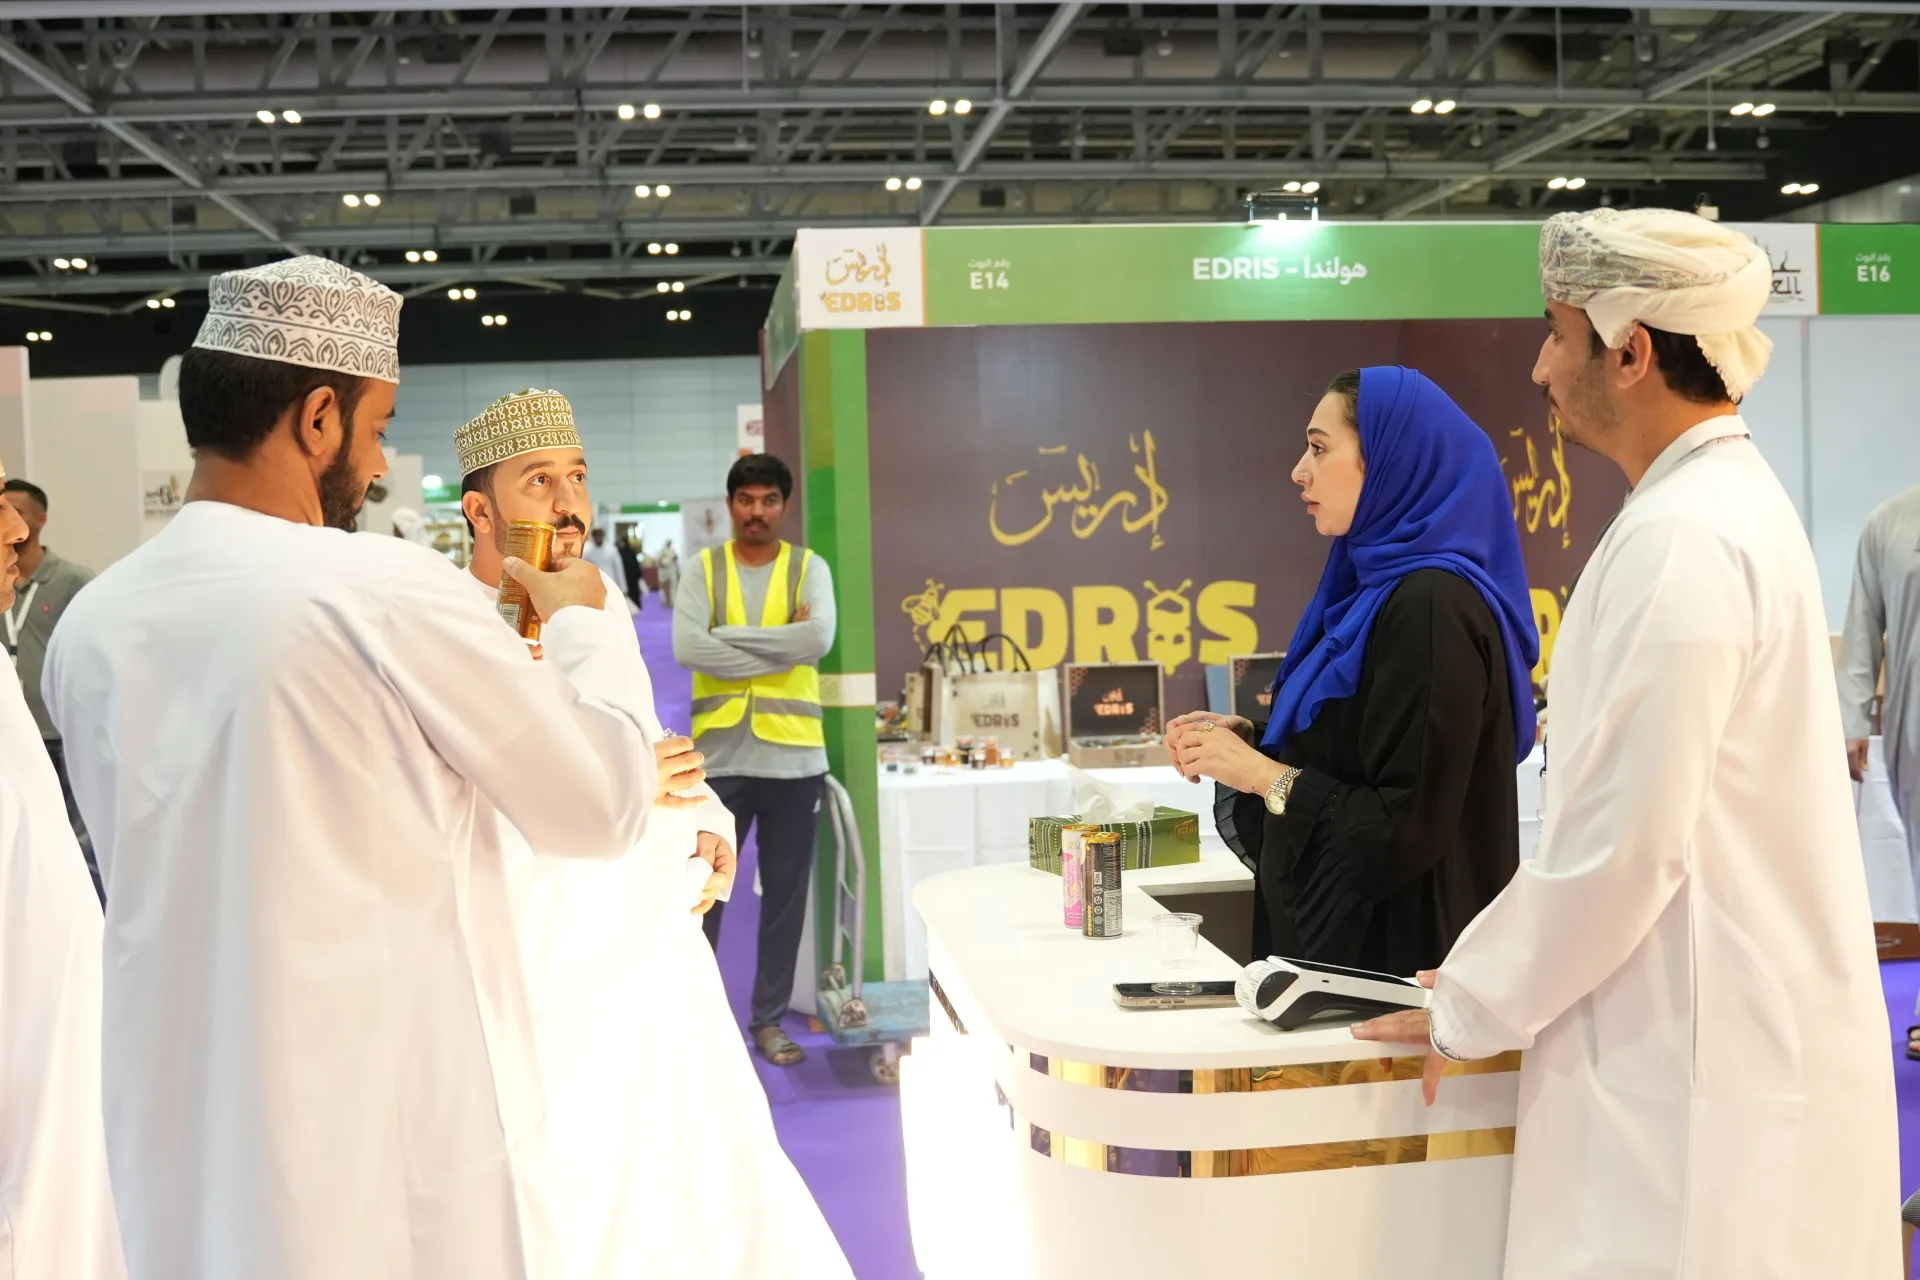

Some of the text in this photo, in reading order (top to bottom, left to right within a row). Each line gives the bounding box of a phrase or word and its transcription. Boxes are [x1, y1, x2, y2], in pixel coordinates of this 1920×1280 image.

[969, 271, 1011, 291] E14
[1193, 257, 1280, 280] EDRIS
[1303, 255, 1368, 285] هولندا
[1856, 264, 1892, 283] E16
[820, 291, 902, 313] EDRIS
[926, 579, 1260, 676] EDRIS
